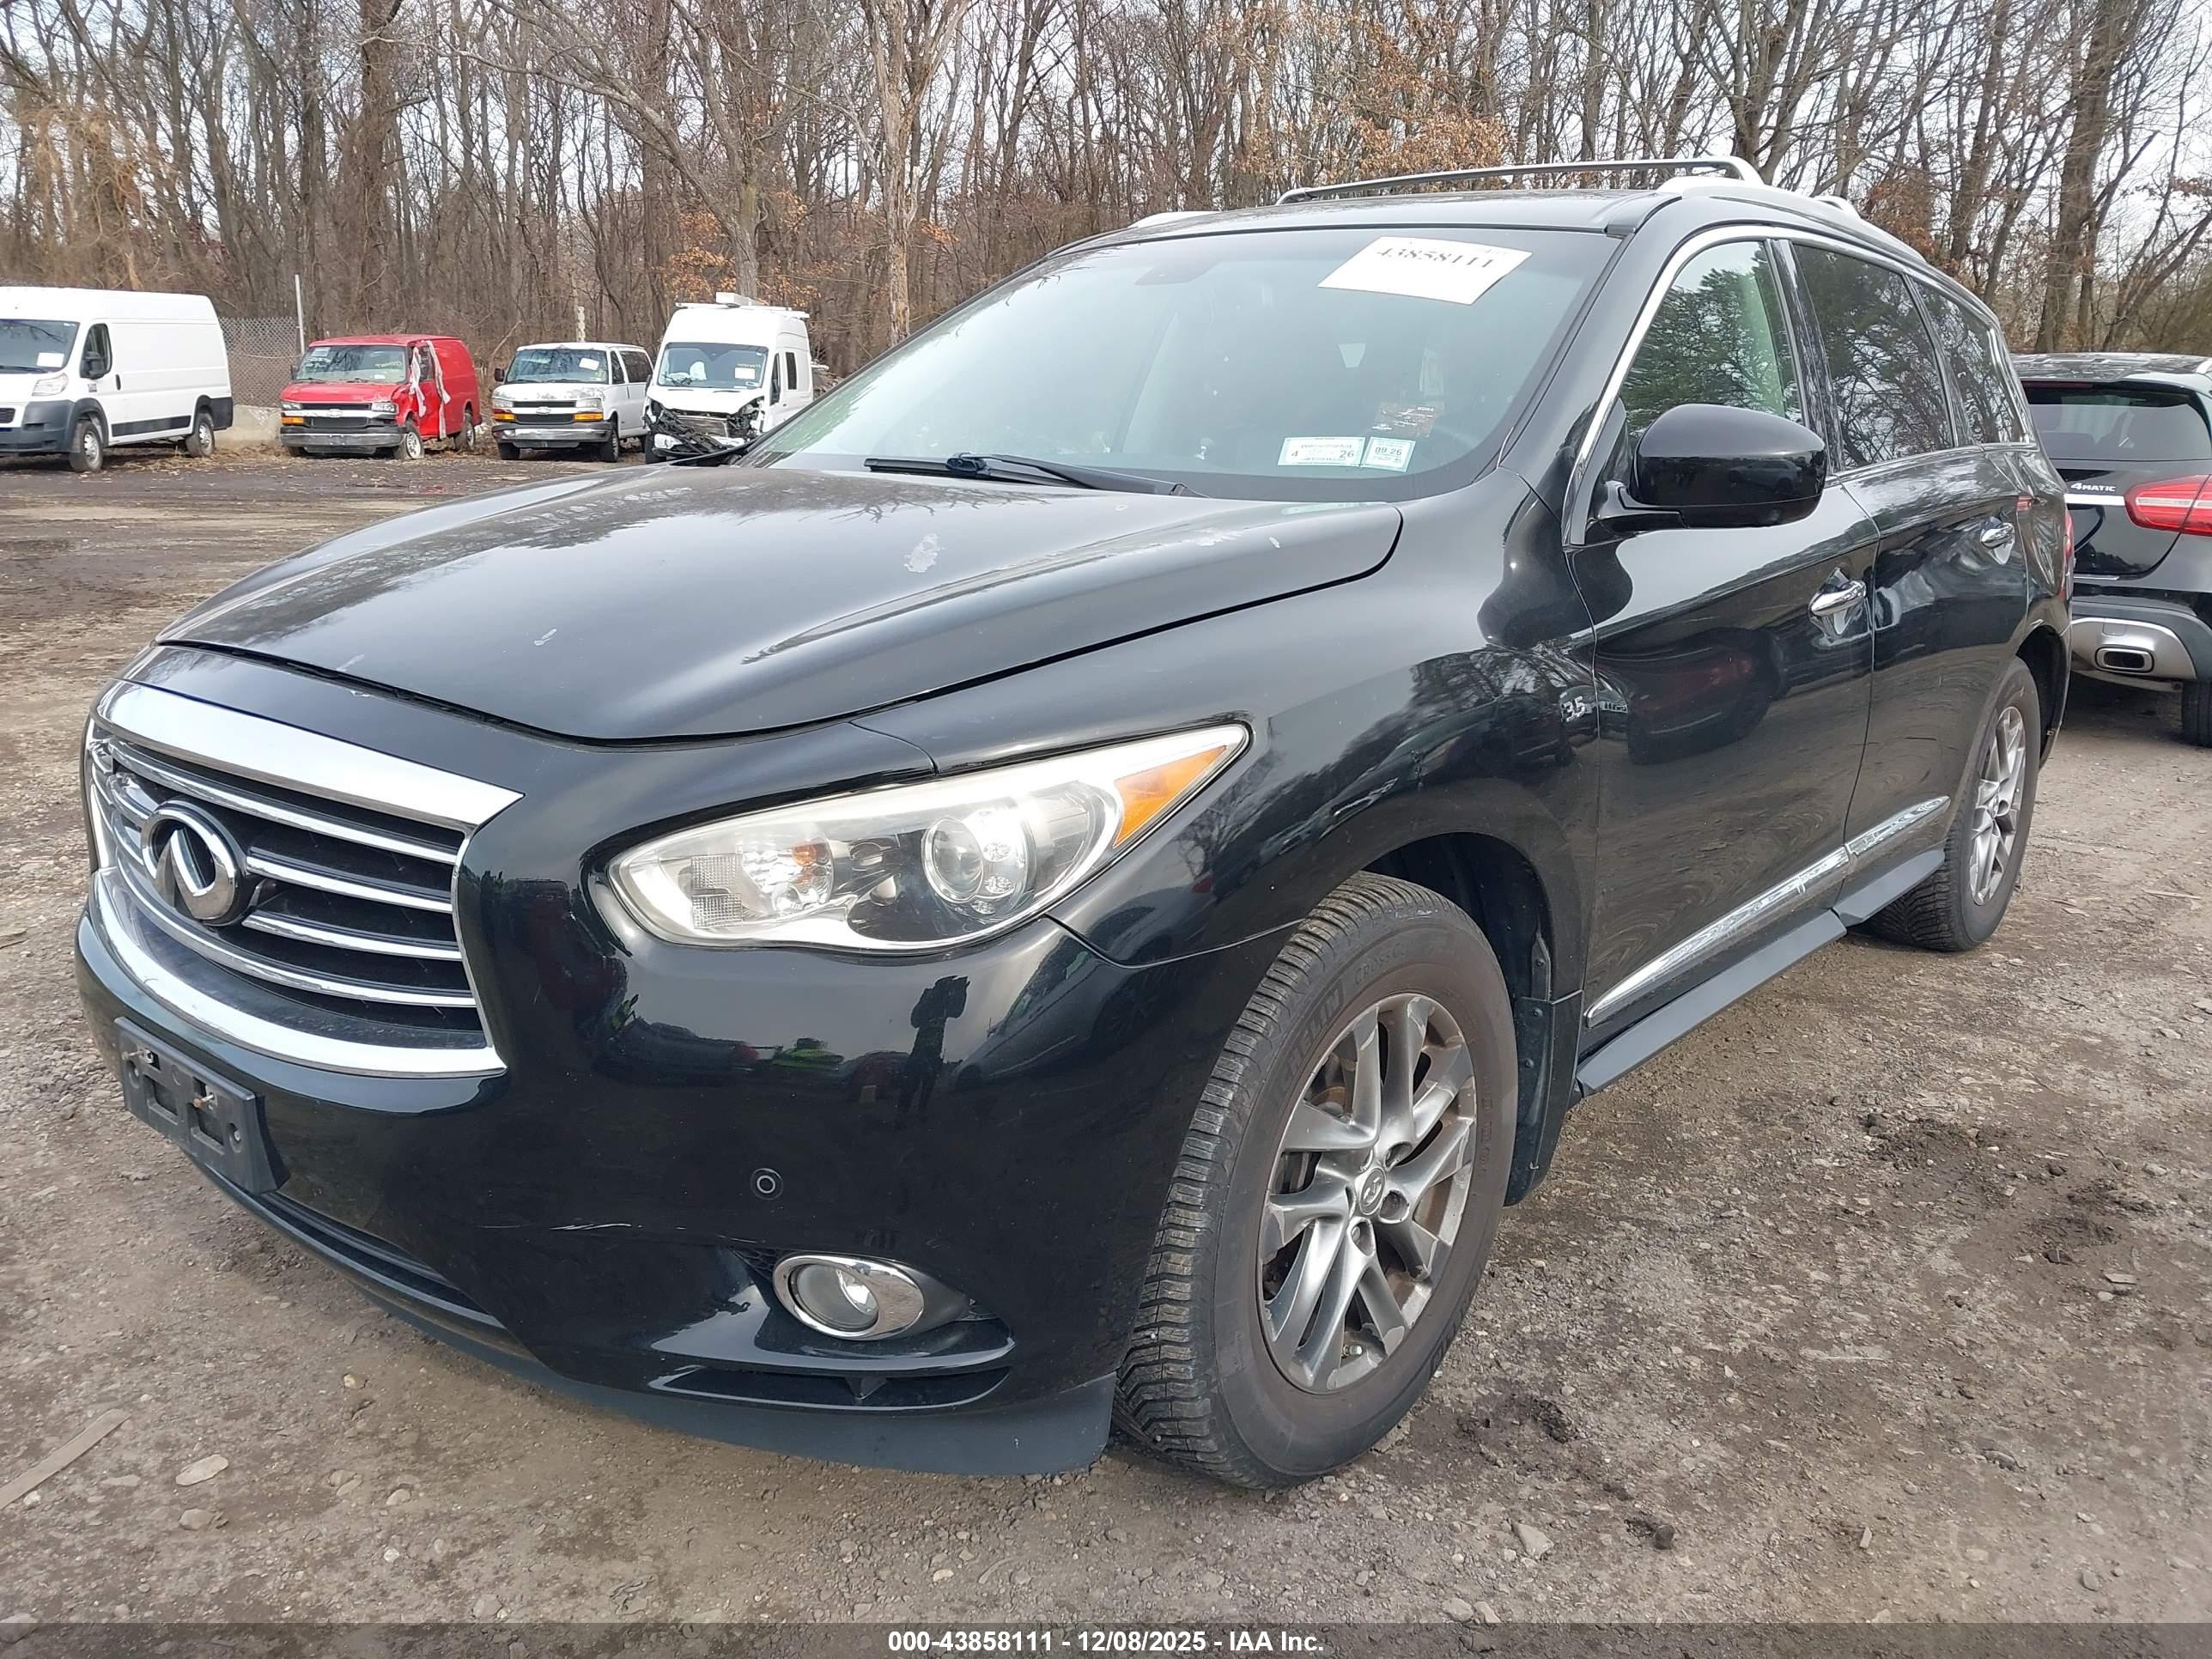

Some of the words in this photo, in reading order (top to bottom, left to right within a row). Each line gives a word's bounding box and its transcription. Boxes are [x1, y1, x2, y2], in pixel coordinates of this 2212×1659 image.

[1377, 247, 1494, 268] 43858111
[1339, 449, 1355, 459] 26
[1389, 447, 1403, 457] 26
[2070, 483, 2117, 492] 4MATIC
